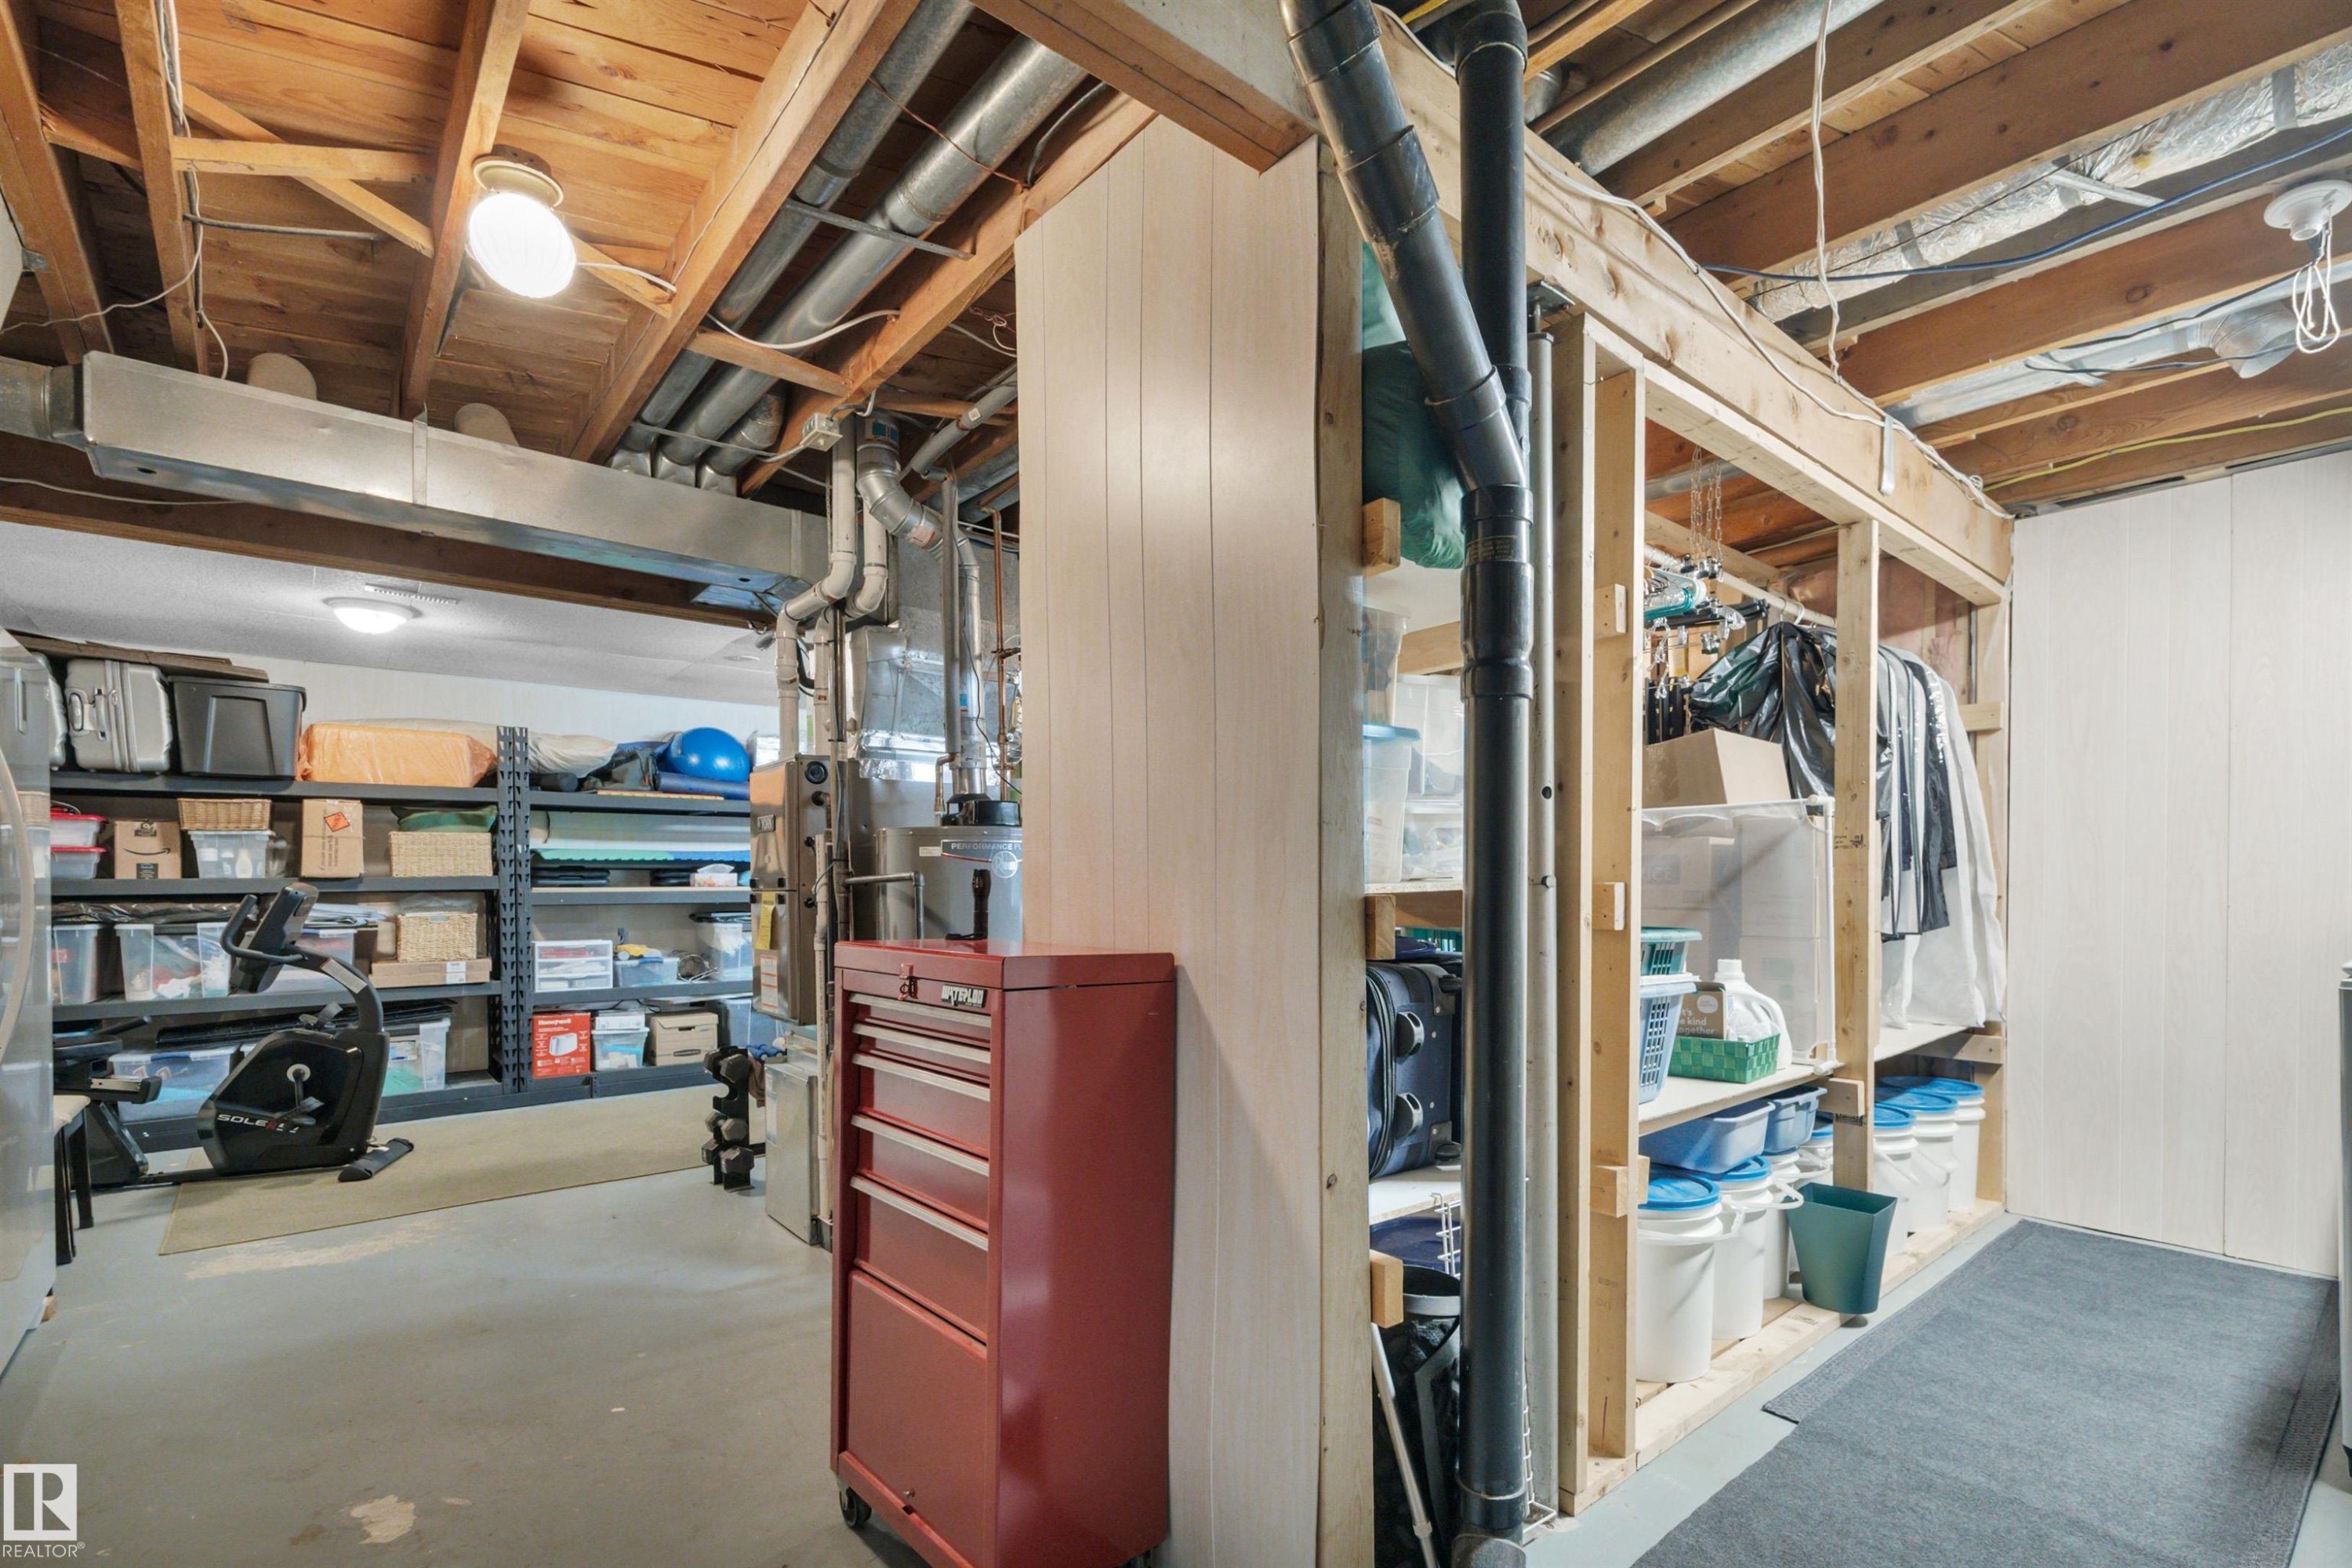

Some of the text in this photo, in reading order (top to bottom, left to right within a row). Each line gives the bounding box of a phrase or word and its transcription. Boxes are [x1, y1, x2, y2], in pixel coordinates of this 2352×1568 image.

[941, 985, 984, 1006] WATERLOO
[538, 1018, 571, 1026] Honeywell
[1687, 1017, 1707, 1025] kind
[1677, 1025, 1715, 1035] ogether
[217, 1113, 268, 1127] SOLE
